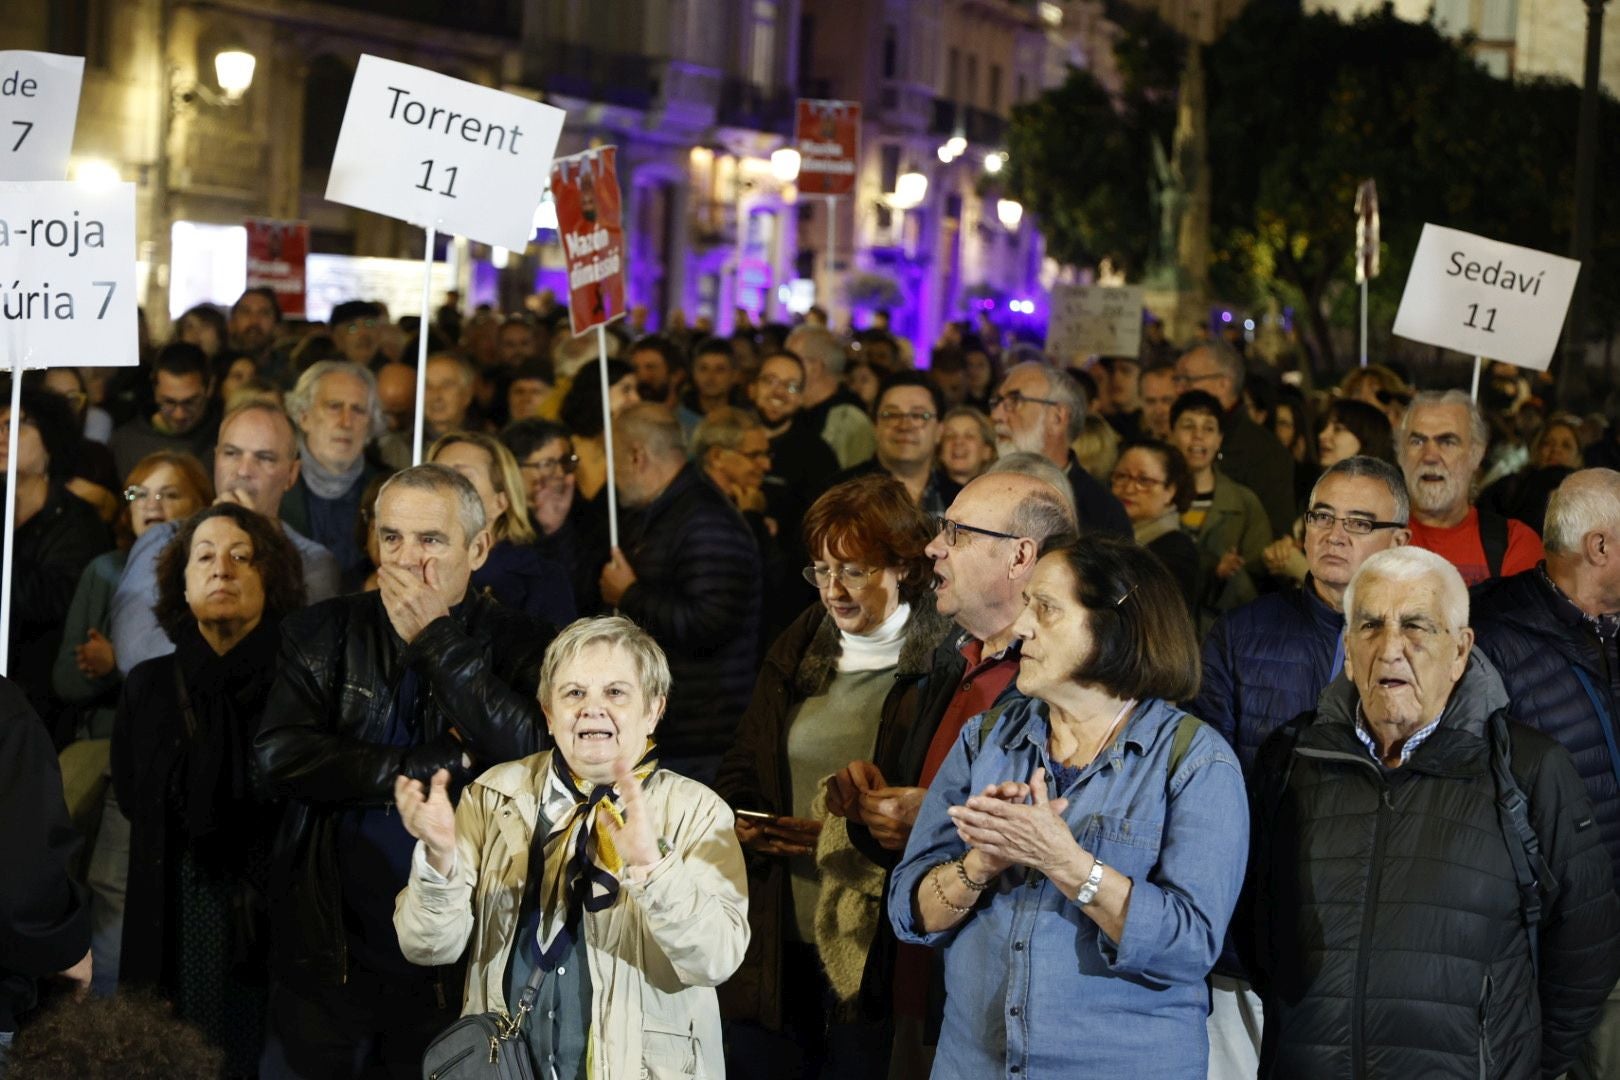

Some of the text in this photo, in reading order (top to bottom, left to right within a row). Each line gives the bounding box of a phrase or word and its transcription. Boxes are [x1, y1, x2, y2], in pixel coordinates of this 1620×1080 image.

[2, 70, 38, 98] de
[12, 120, 34, 152] 7
[387, 86, 524, 155] Torrent
[415, 159, 459, 199] 11
[1446, 251, 1546, 296] Sedaví
[0, 280, 118, 320] úria 7
[1463, 303, 1497, 333] 11
